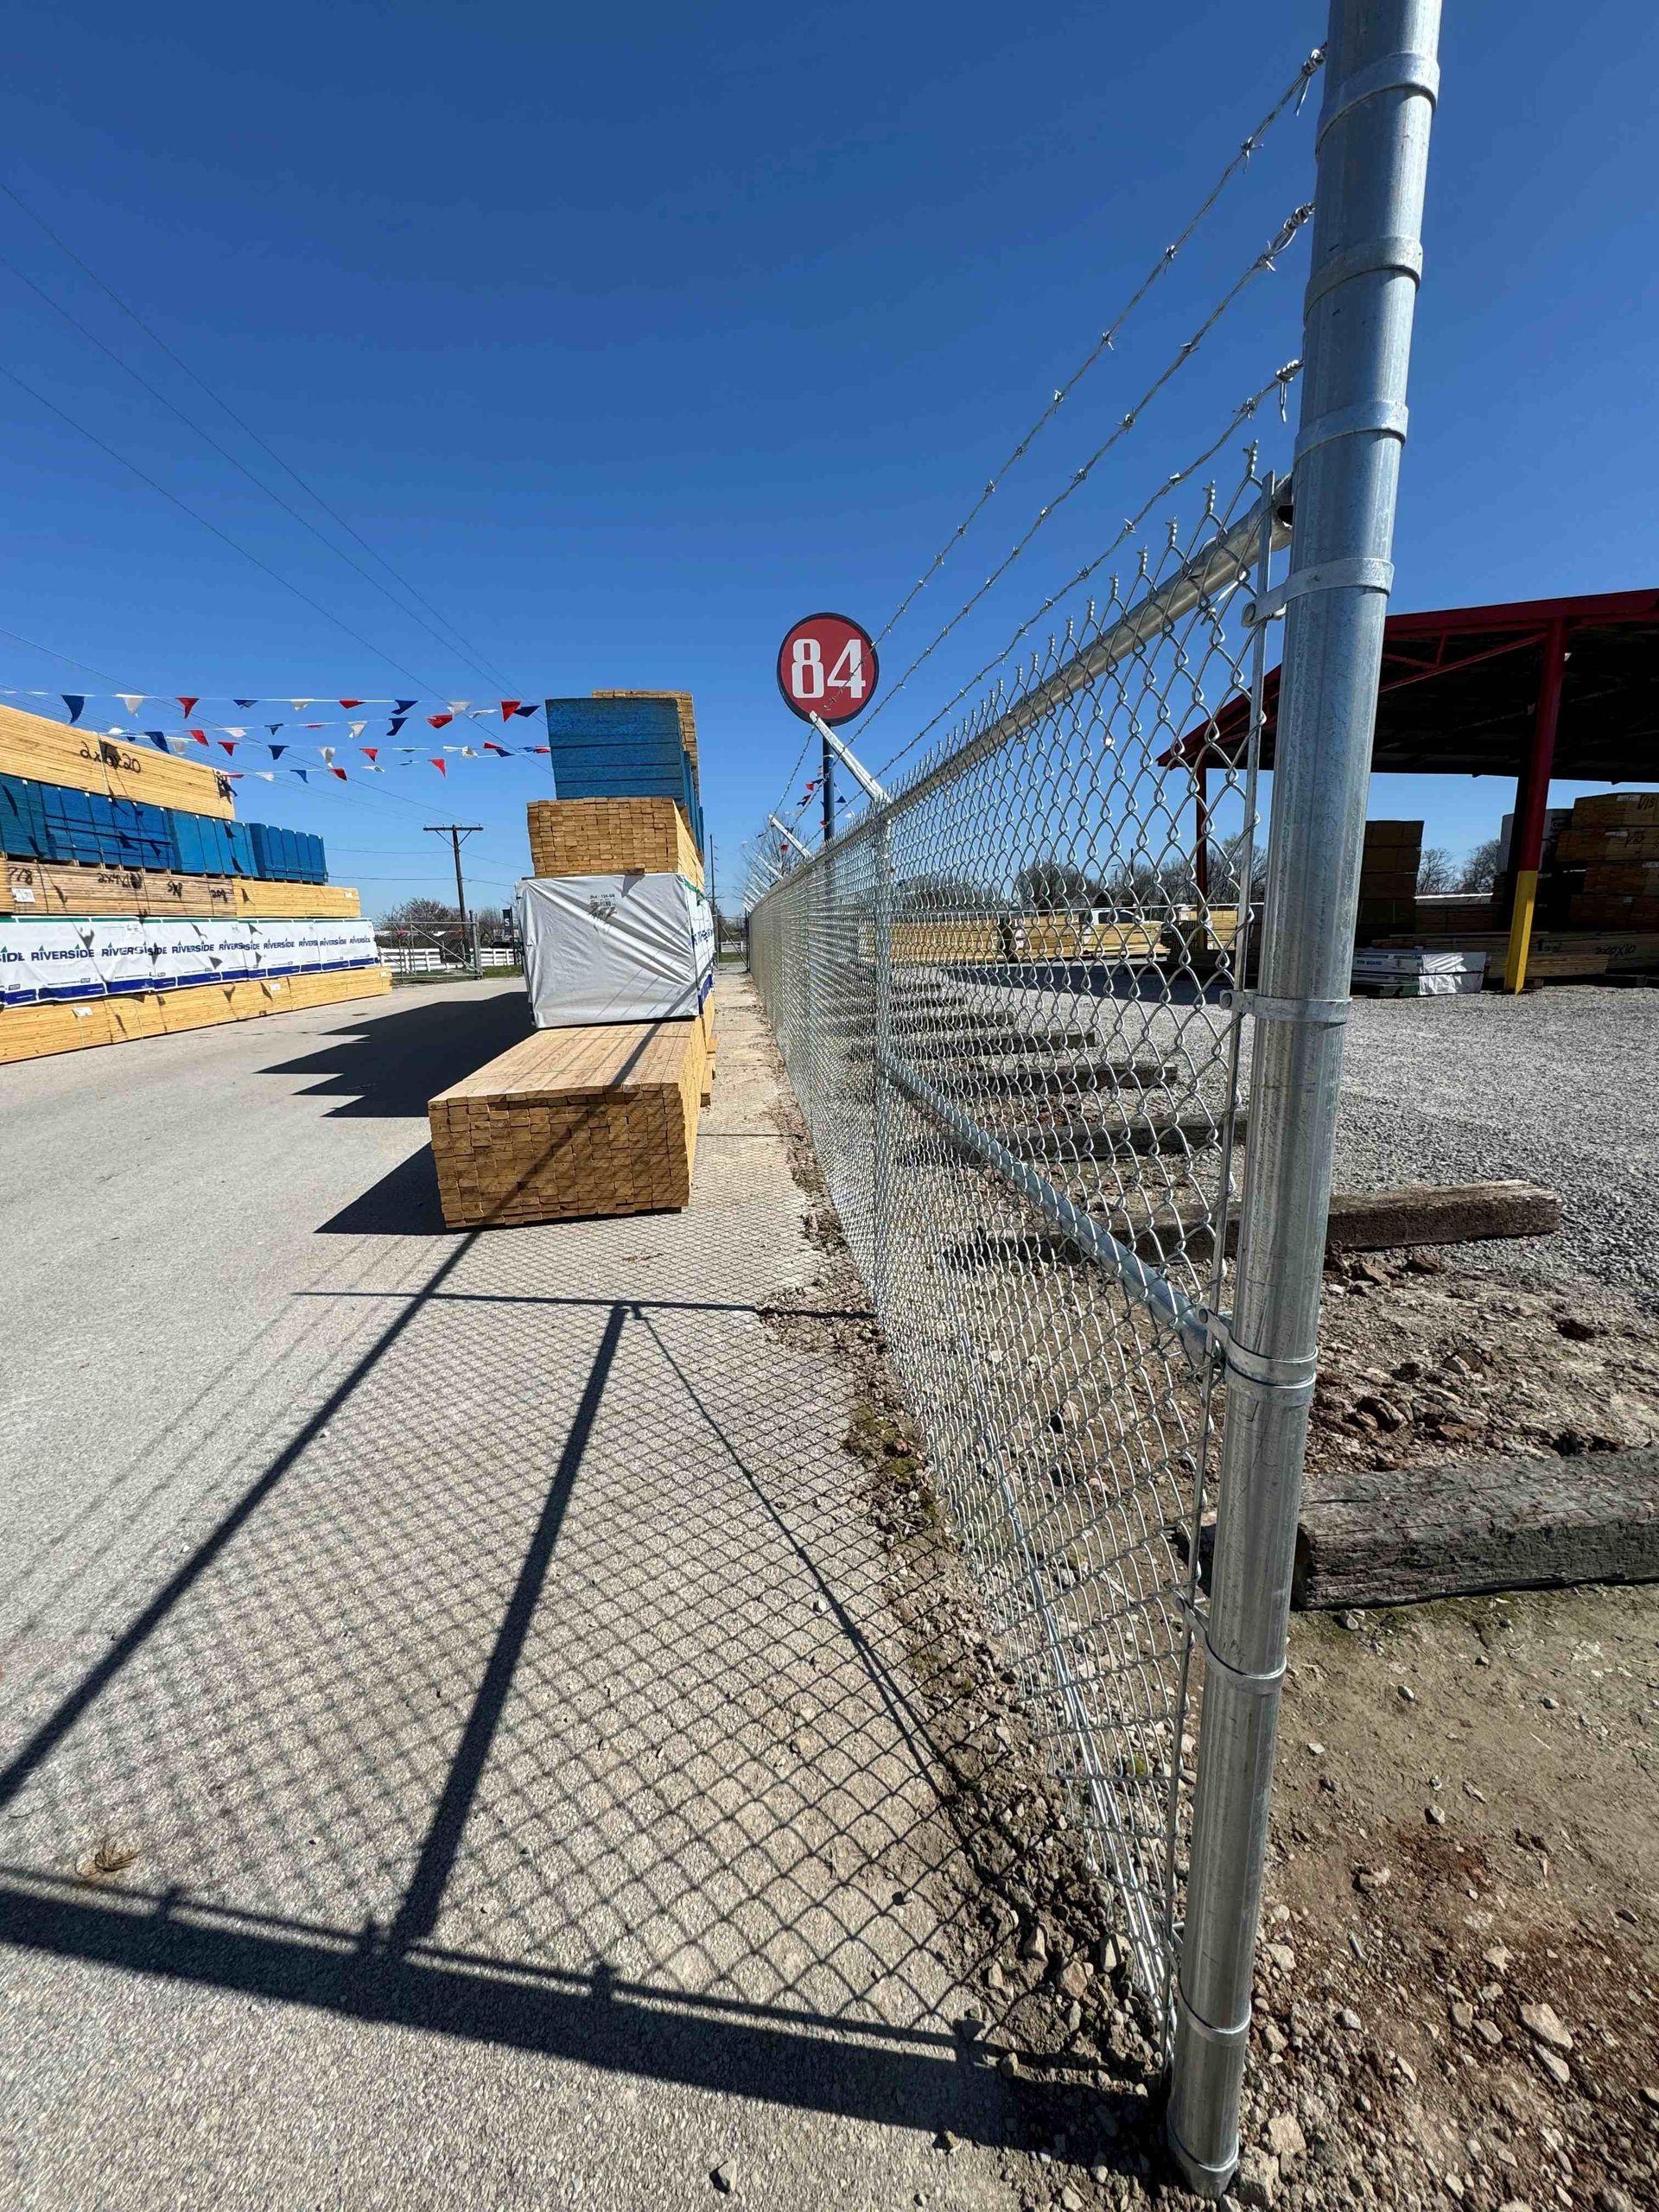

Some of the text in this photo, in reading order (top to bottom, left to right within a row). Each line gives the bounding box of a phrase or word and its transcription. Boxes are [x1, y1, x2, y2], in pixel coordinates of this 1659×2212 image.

[791, 639, 867, 699] 84
[264, 940, 296, 950] RIVERSIDE
[320, 938, 347, 947] RIVERSIDE
[171, 944, 215, 955] RIVERSIDE
[31, 949, 95, 962] RIVERSIDE
